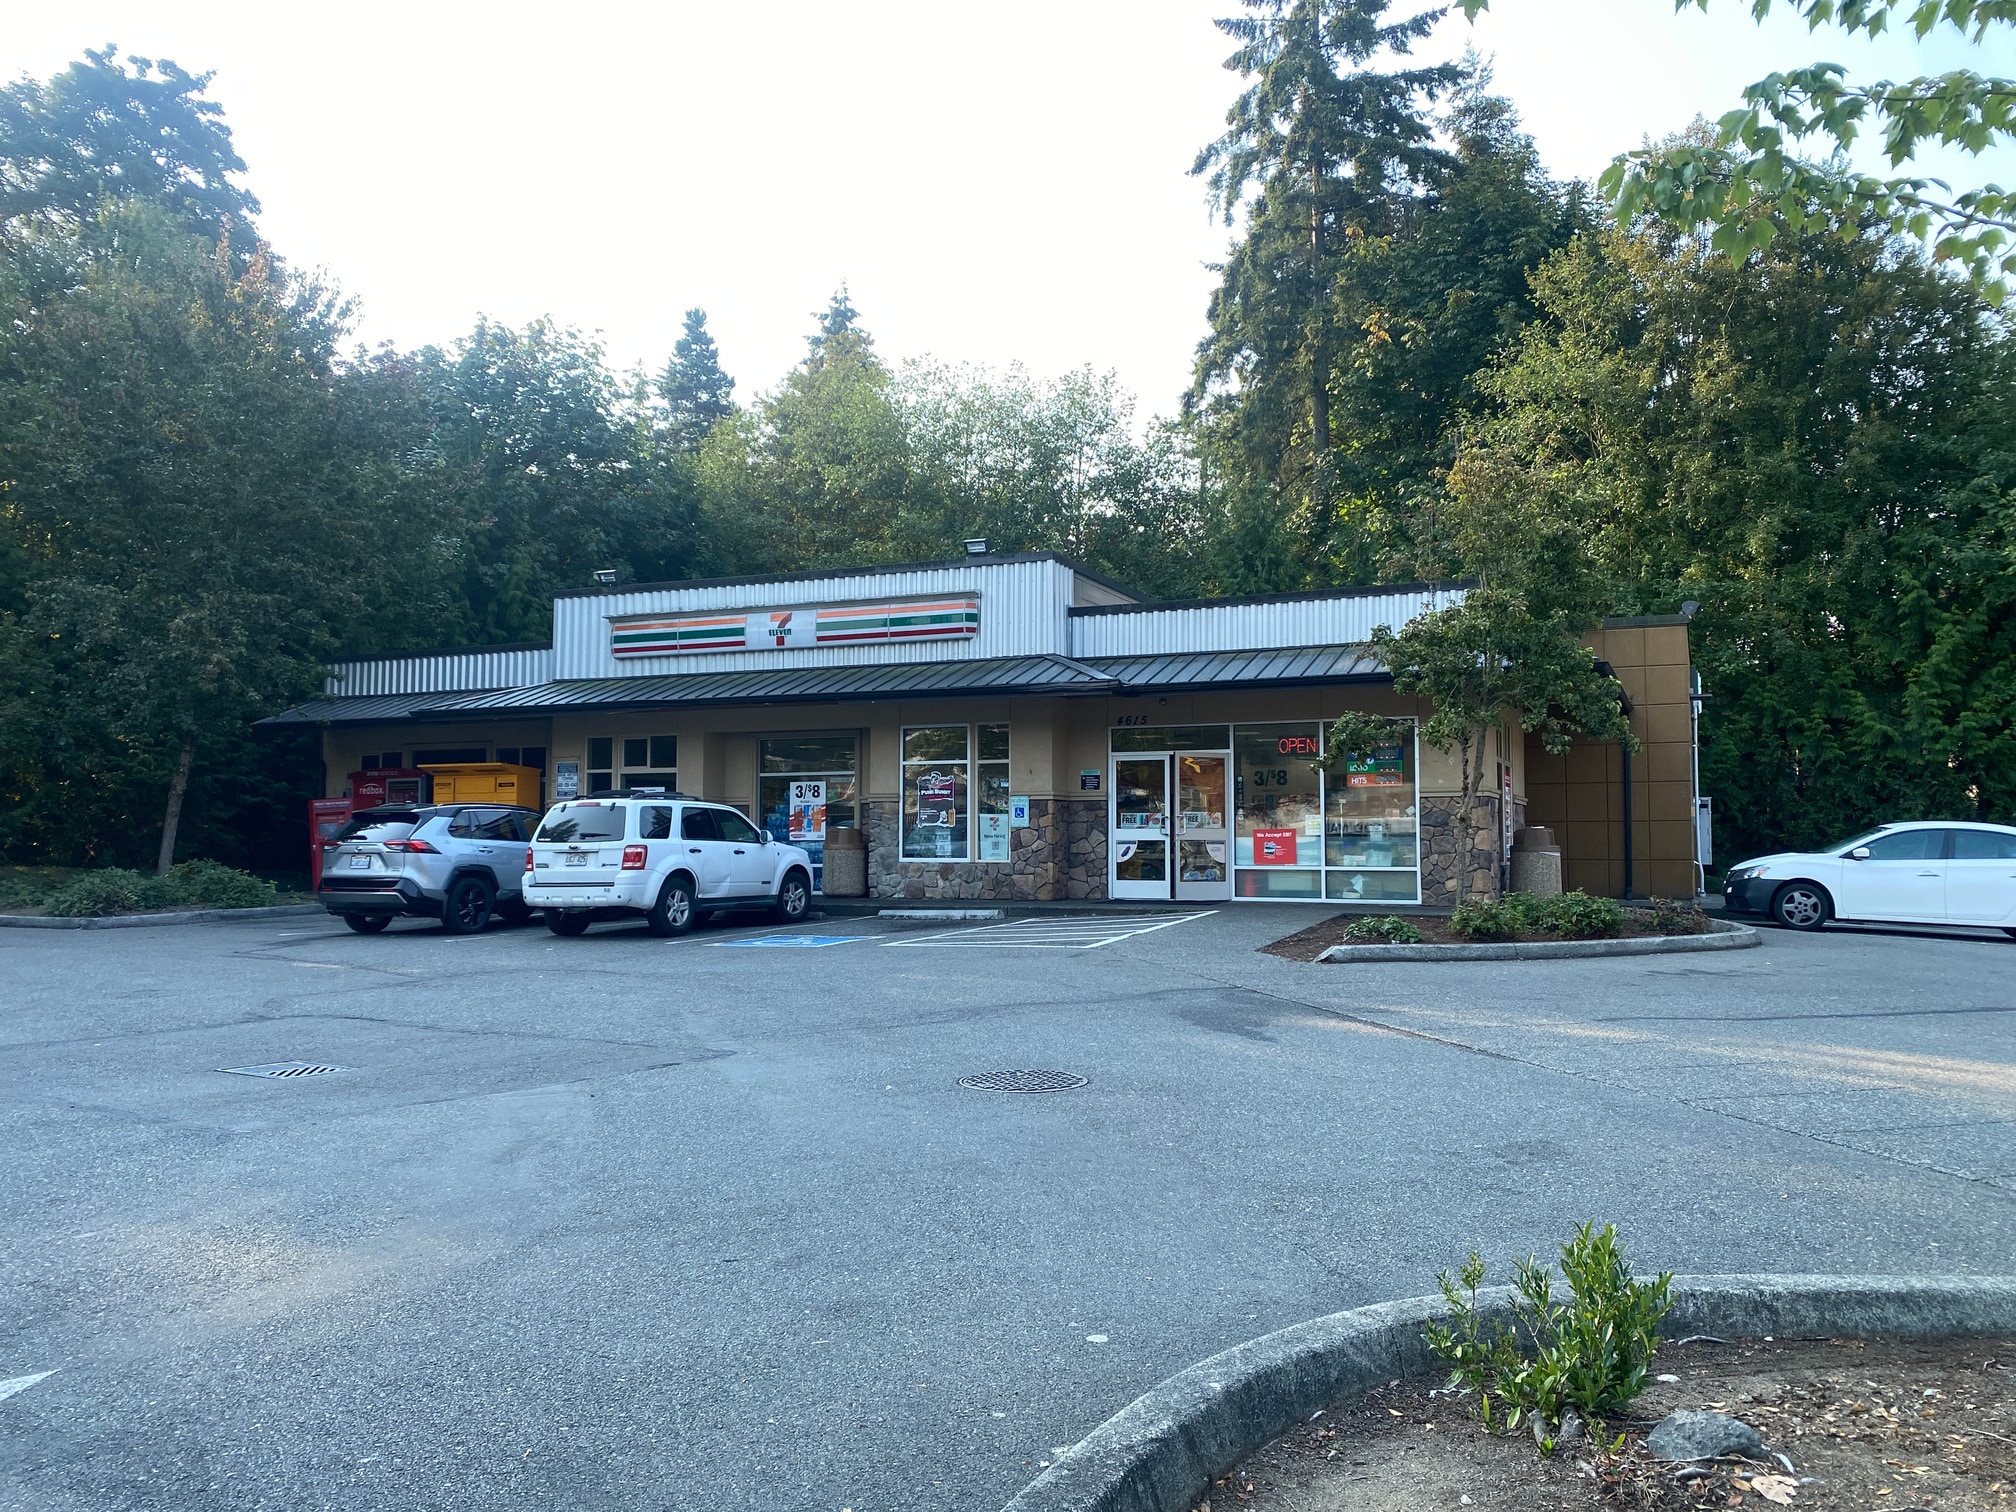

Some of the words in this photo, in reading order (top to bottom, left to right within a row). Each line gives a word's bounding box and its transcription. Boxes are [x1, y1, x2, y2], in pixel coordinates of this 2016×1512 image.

[770, 612, 792, 646] 7
[1117, 715, 1148, 725] 4615
[1278, 737, 1318, 754] OPEN
[1254, 769, 1288, 787] 3/$8
[795, 784, 821, 799] 3/$8
